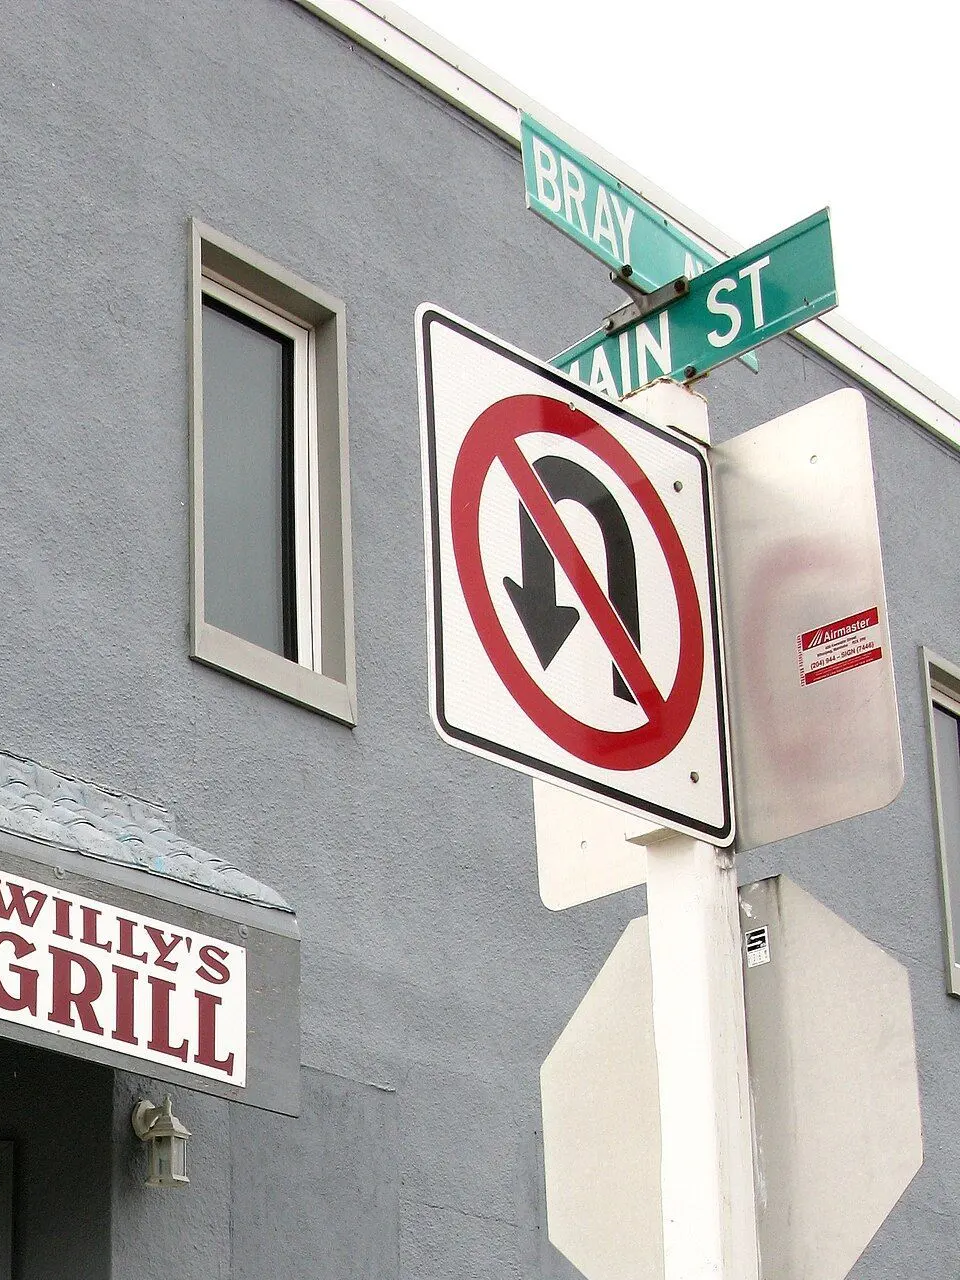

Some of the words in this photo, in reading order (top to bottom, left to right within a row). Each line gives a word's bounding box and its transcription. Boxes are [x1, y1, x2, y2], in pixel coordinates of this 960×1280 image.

[532, 136, 635, 265] BRAY
[706, 255, 770, 349] ST
[823, 617, 870, 642] Airmaster
